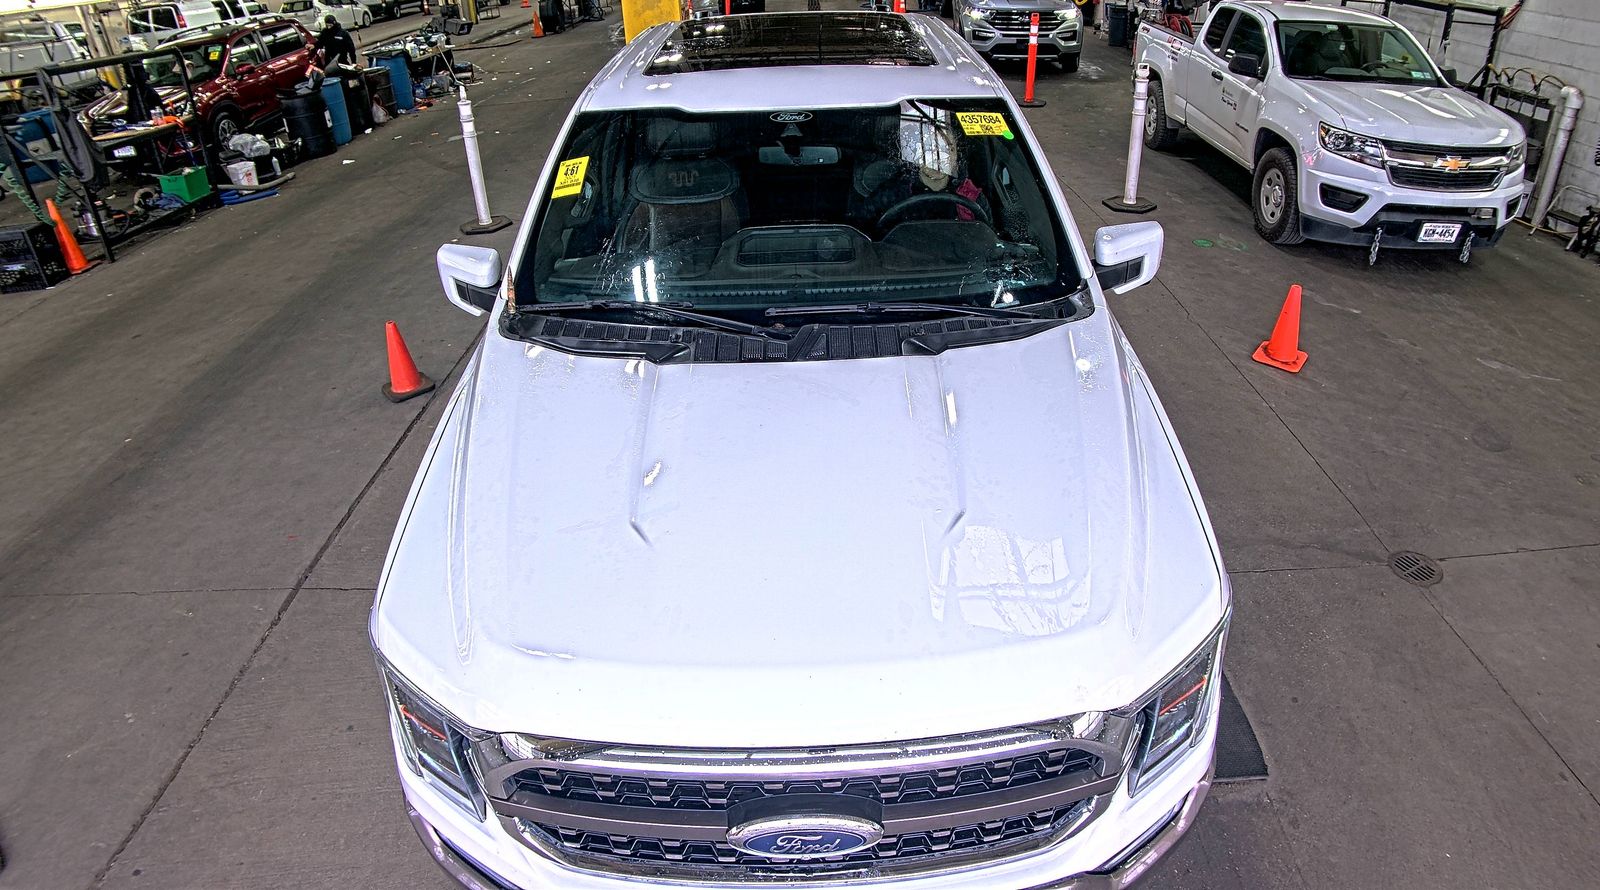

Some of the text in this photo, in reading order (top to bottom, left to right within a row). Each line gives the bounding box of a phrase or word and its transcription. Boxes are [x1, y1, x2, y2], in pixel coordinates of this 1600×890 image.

[777, 111, 806, 121] Ford
[960, 114, 1002, 124] 4357684
[770, 835, 841, 853] Ford
